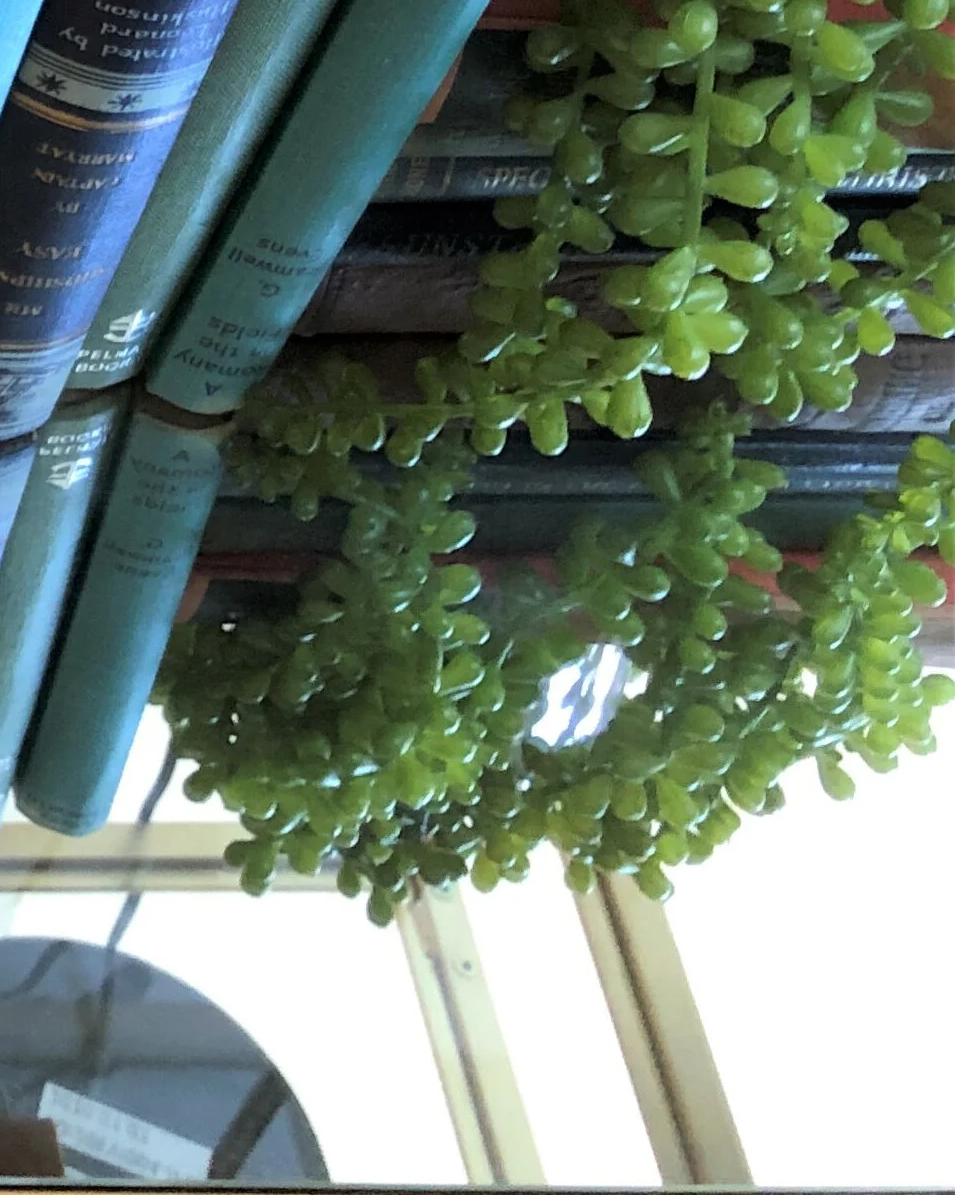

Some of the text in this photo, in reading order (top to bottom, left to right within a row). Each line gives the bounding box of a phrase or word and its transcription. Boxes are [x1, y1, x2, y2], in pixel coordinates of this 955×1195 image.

[58, 26, 88, 53] by
[100, 22, 209, 41] Lonard
[173, 348, 264, 377] omany
[205, 381, 222, 396] A
